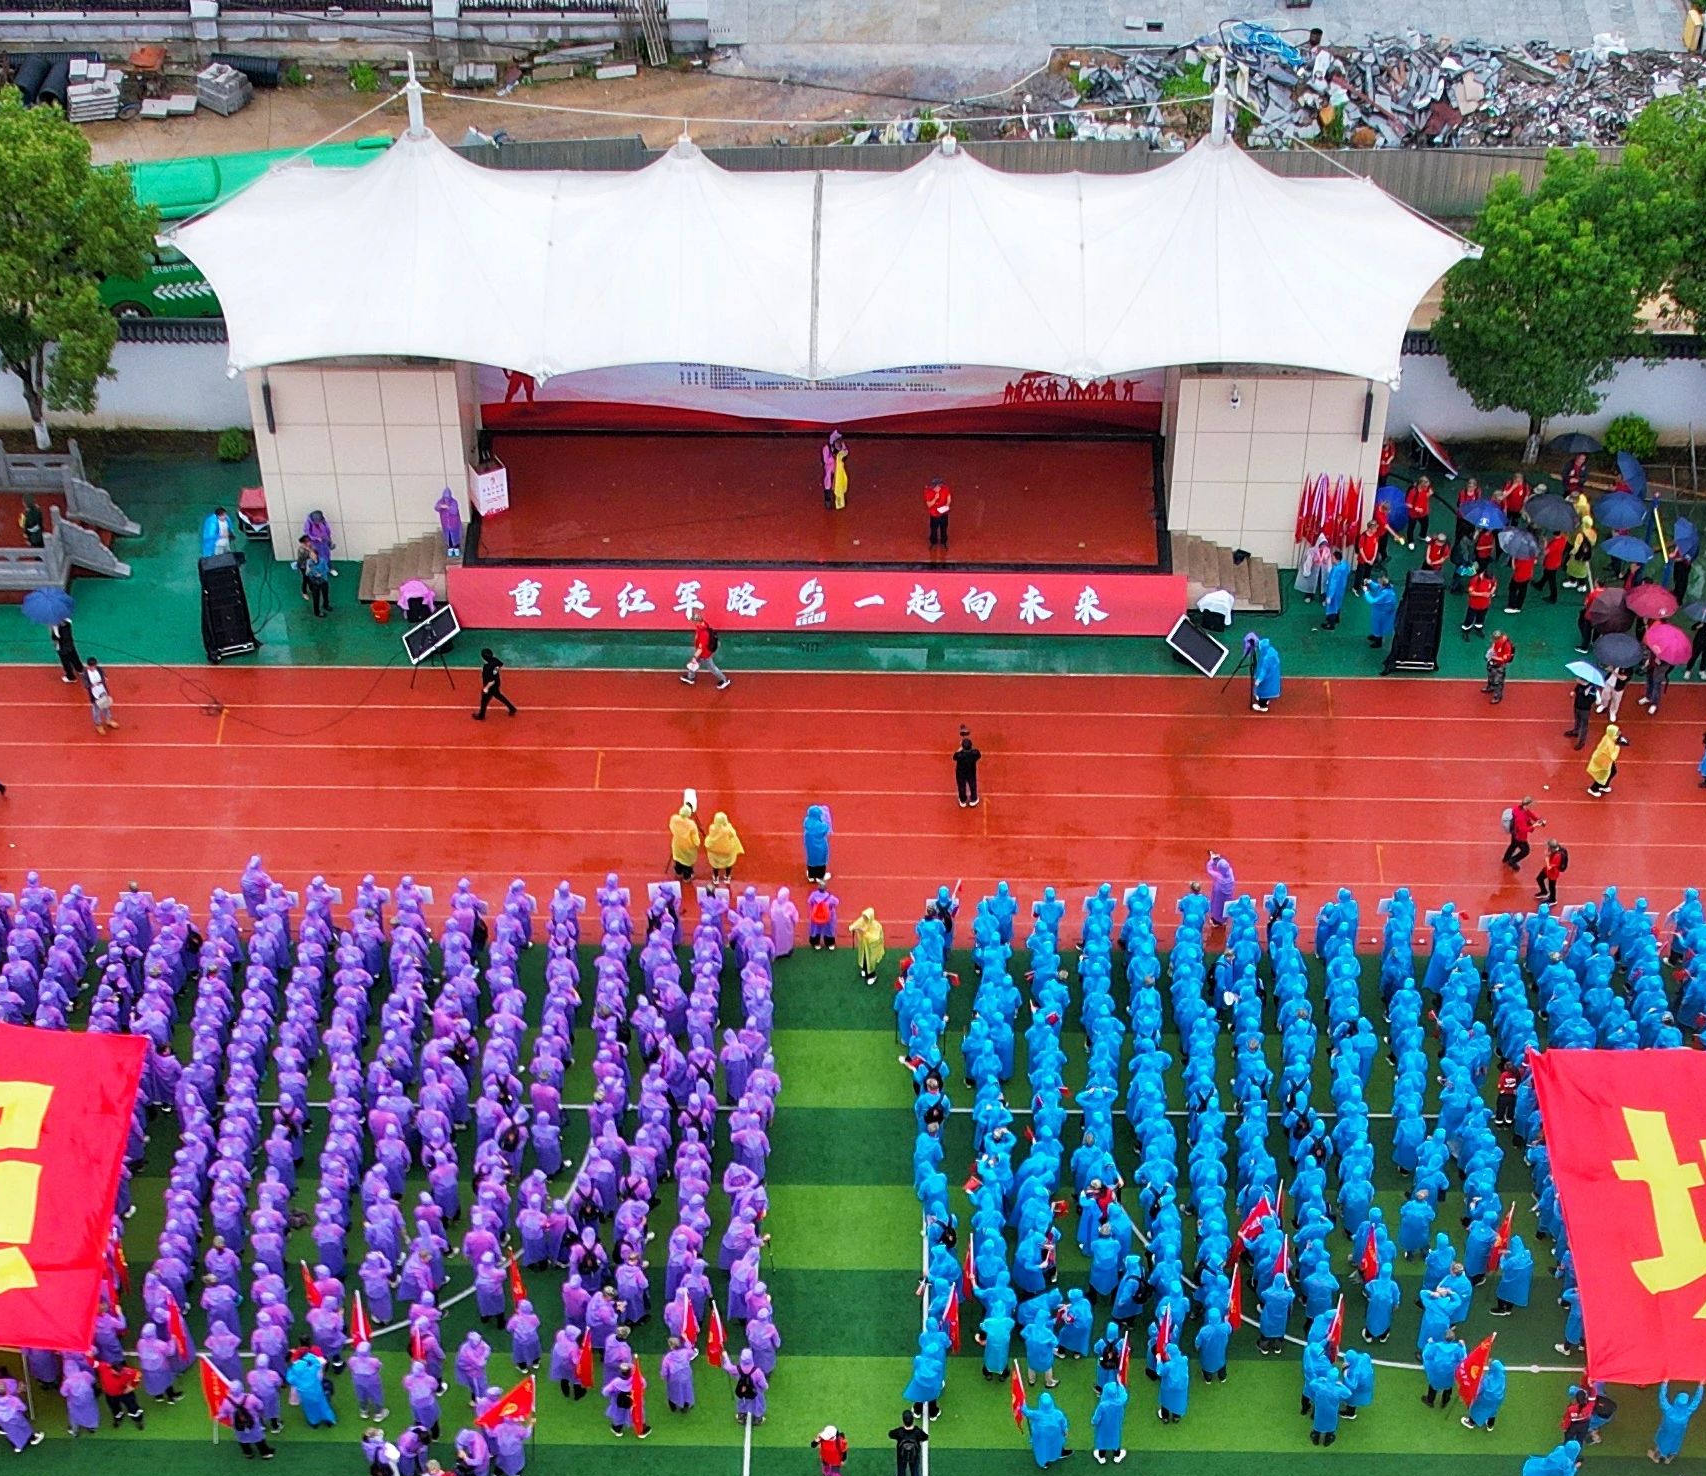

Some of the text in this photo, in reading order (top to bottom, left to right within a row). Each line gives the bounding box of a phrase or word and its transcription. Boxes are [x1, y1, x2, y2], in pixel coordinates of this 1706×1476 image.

[508, 578, 1110, 626] 重走红军路 一起向未来
